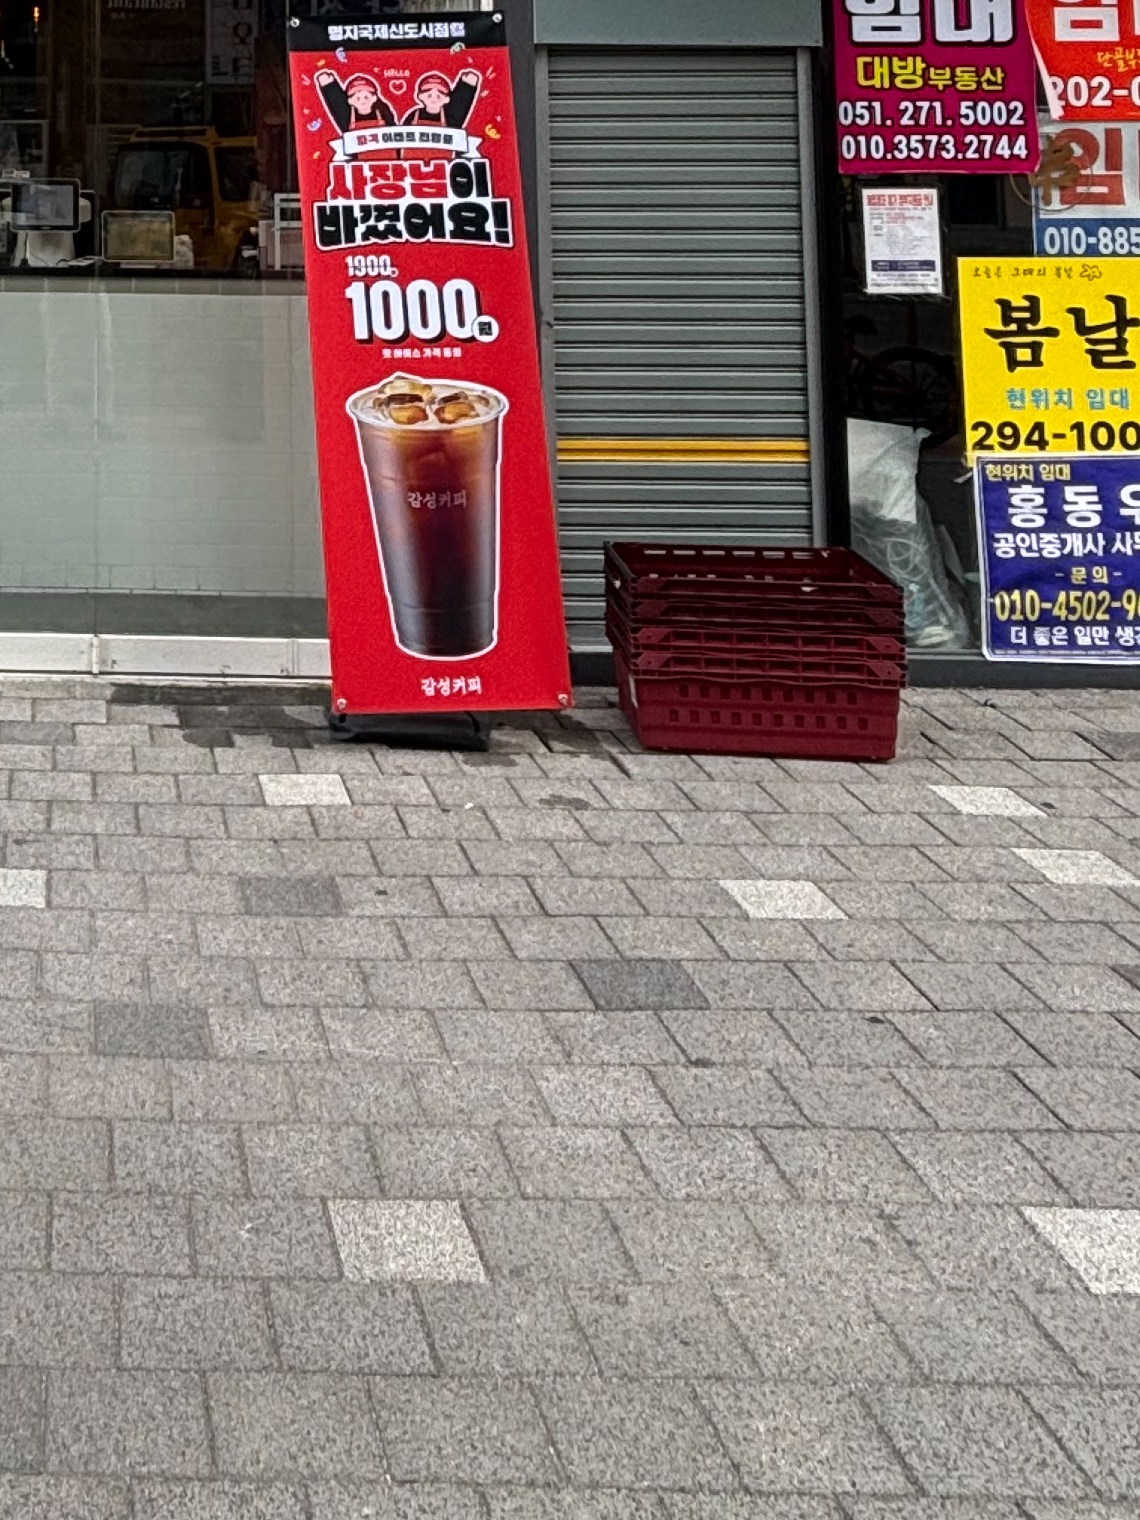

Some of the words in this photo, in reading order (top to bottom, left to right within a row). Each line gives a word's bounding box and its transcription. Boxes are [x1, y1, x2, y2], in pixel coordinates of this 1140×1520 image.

[839, 101, 893, 126] 051.
[899, 101, 953, 126] 271.
[960, 101, 1025, 126] 5002
[841, 134, 1028, 160] 010.3573.2744
[328, 160, 490, 201] 사장님이
[983, 294, 1140, 373] 봄날
[1006, 387, 1073, 410] 현위치
[1086, 387, 1129, 410] 임대
[970, 421, 1140, 451] 294-100
[985, 464, 1034, 482] 현위치
[1039, 464, 1071, 481] 임대
[407, 489, 468, 510] 감성커피
[993, 532, 1106, 559] 공인중개사
[994, 588, 1140, 622] 010-4502-9
[1010, 627, 1028, 646] 더
[1033, 627, 1068, 647] 좋은
[1074, 626, 1110, 646] 일만
[420, 675, 482, 697] 감성커피
